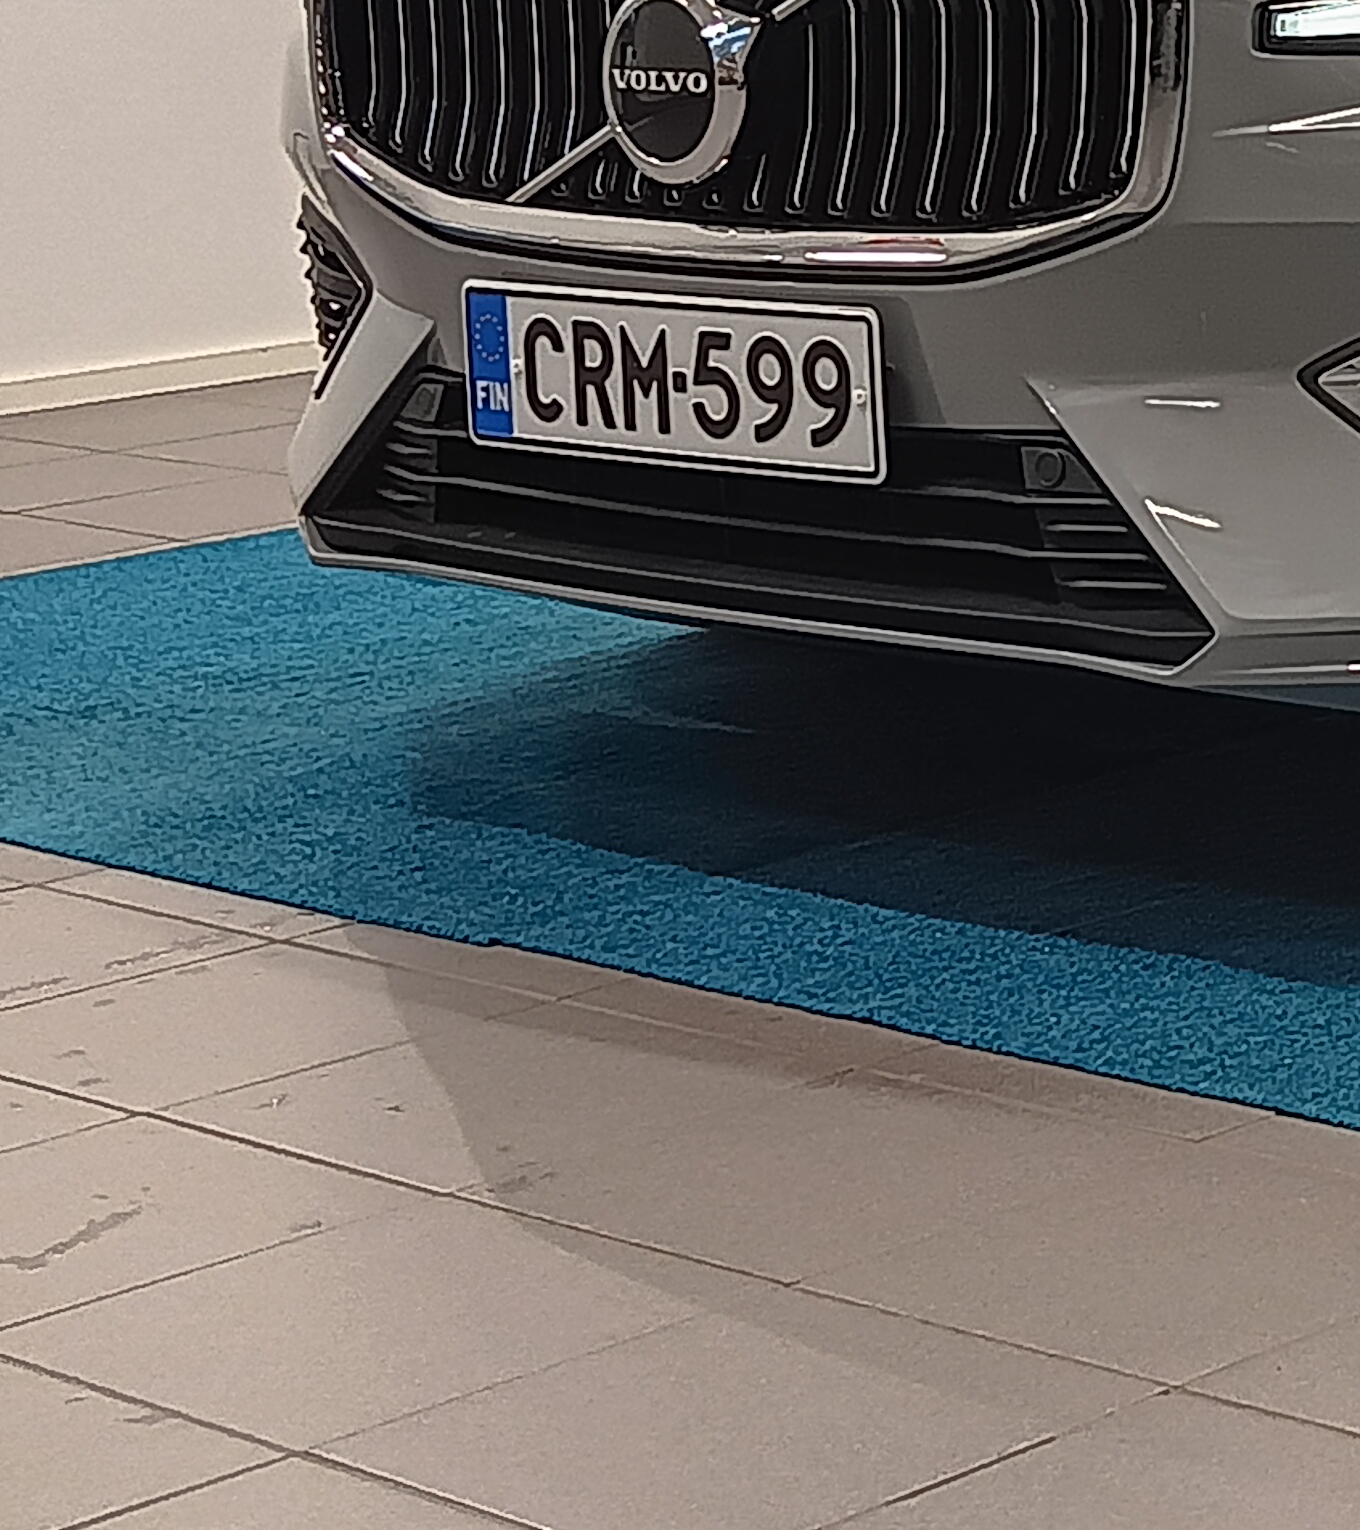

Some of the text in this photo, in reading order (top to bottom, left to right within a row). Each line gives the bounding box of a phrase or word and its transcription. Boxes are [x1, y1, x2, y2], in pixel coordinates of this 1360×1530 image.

[611, 68, 708, 93] VOLVO
[476, 379, 509, 412] FIN
[523, 316, 852, 448] CRM-599
